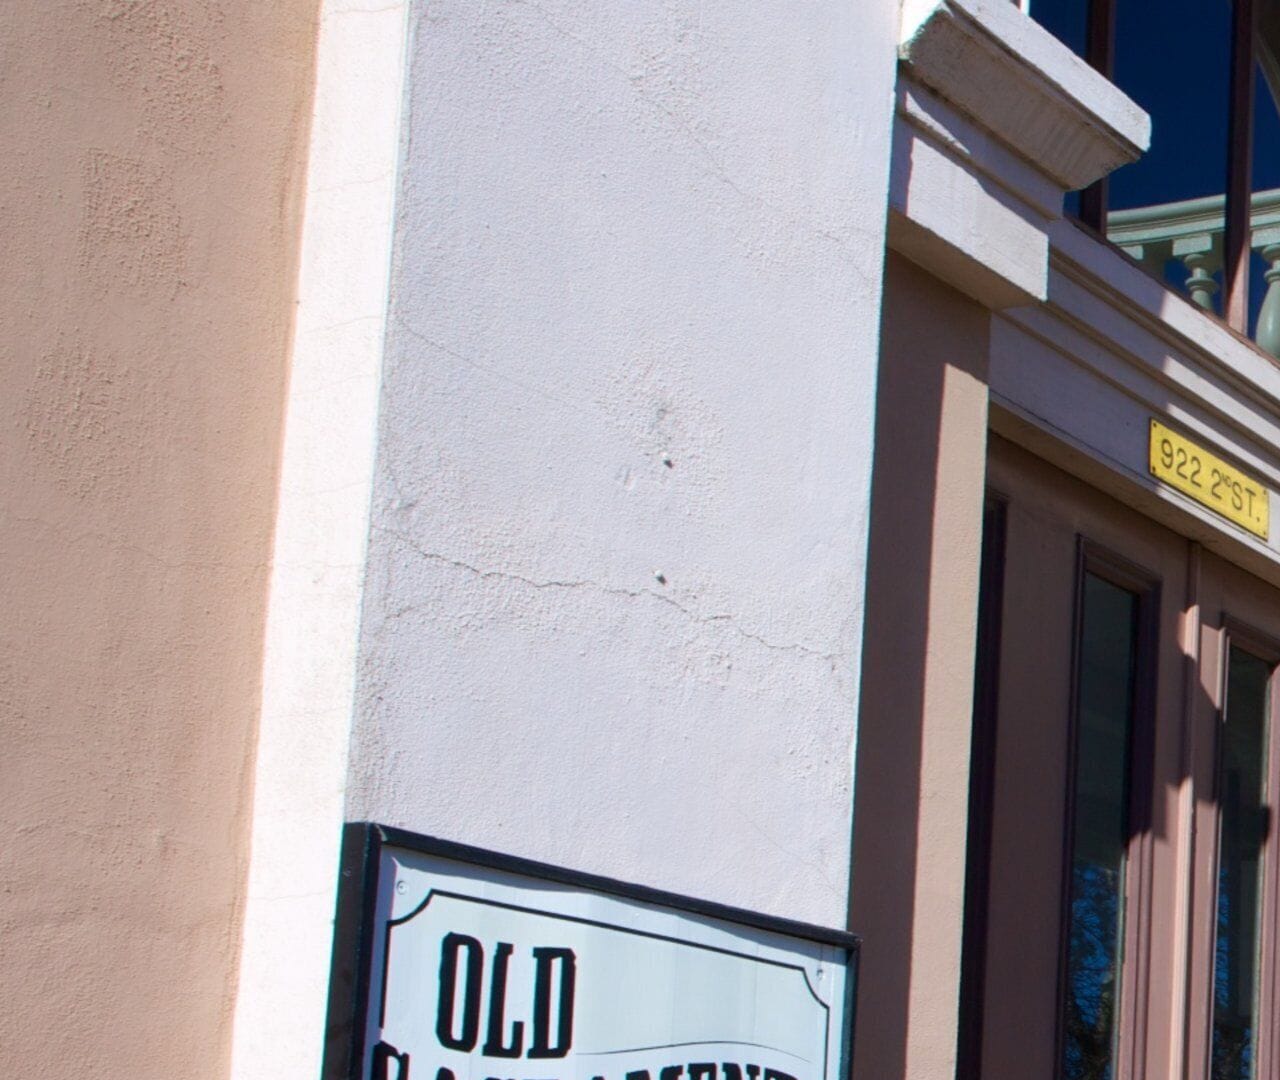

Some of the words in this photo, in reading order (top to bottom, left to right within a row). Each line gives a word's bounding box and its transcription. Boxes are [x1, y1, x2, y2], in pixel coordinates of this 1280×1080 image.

[1161, 438, 1201, 488] 922
[1231, 481, 1260, 522] ST.
[435, 931, 577, 1061] OLD
